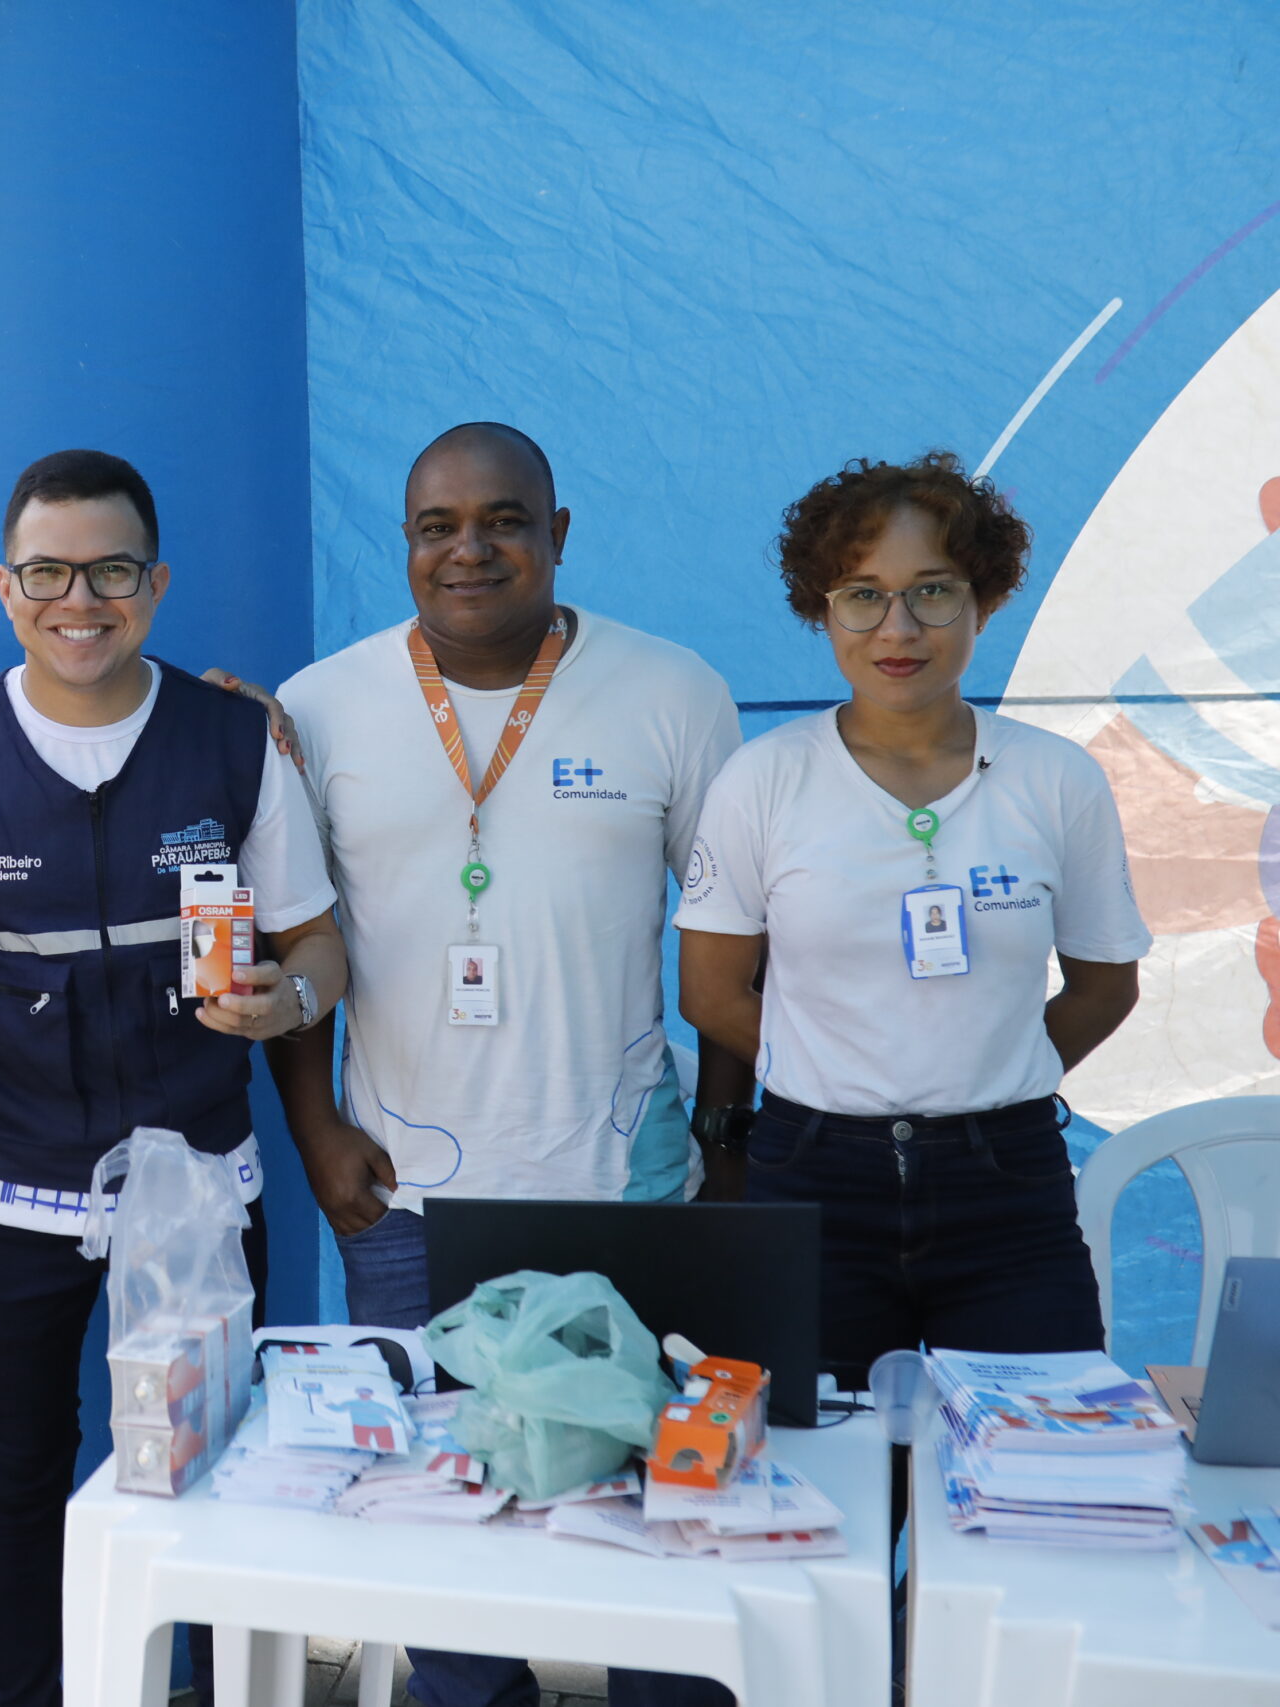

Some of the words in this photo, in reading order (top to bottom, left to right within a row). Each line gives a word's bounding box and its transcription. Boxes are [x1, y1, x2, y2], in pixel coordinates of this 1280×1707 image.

[431, 699, 450, 723] 3e
[508, 710, 532, 734] 3e
[553, 789, 627, 801] Comunidade
[194, 841, 226, 850] MUNICIPAL
[151, 846, 231, 868] PARAUAPEBAS
[234, 892, 248, 900] LED
[974, 896, 1041, 912] Comunidade
[198, 907, 234, 916] OSRAM
